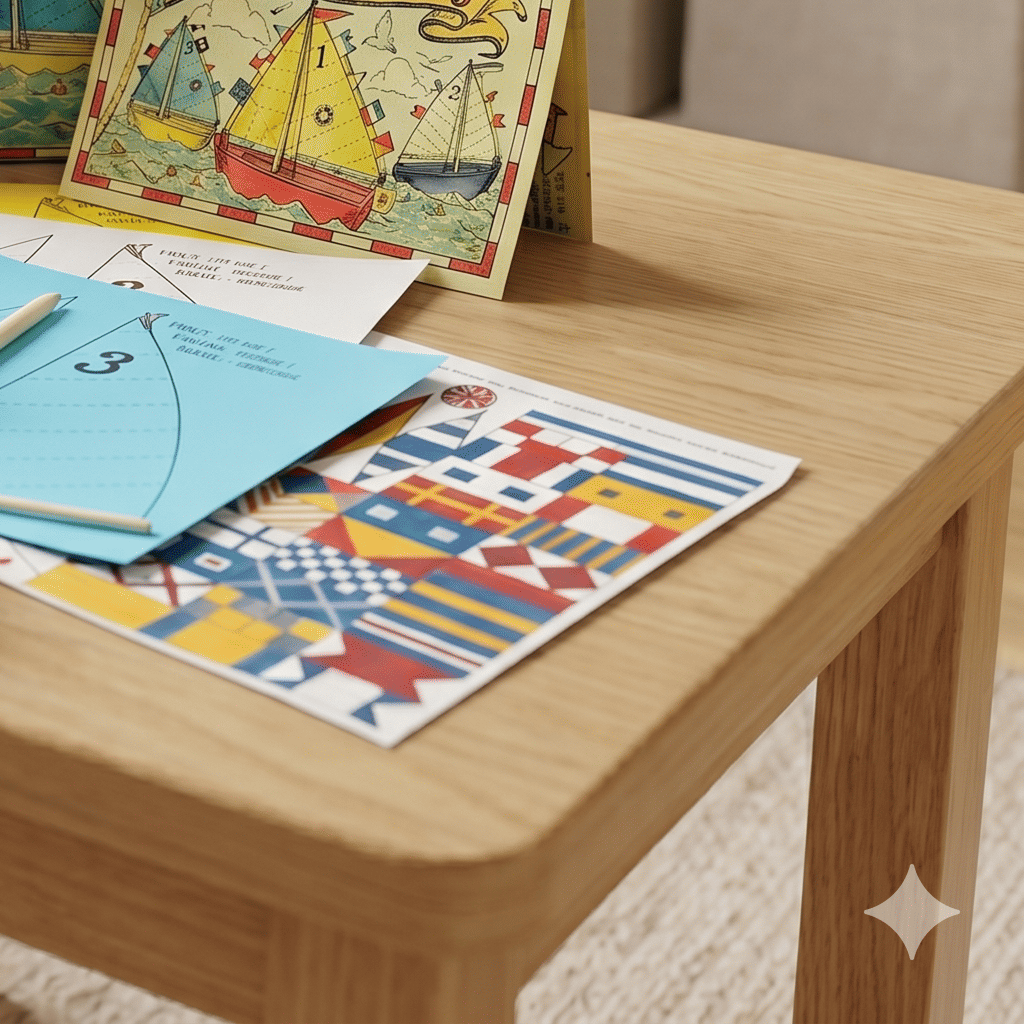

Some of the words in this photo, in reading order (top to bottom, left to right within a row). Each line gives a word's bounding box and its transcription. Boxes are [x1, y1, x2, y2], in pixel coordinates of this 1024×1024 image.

[184, 40, 194, 55] 3
[316, 44, 326, 69] 1
[448, 85, 461, 101] 2
[74, 350, 135, 375] 3
